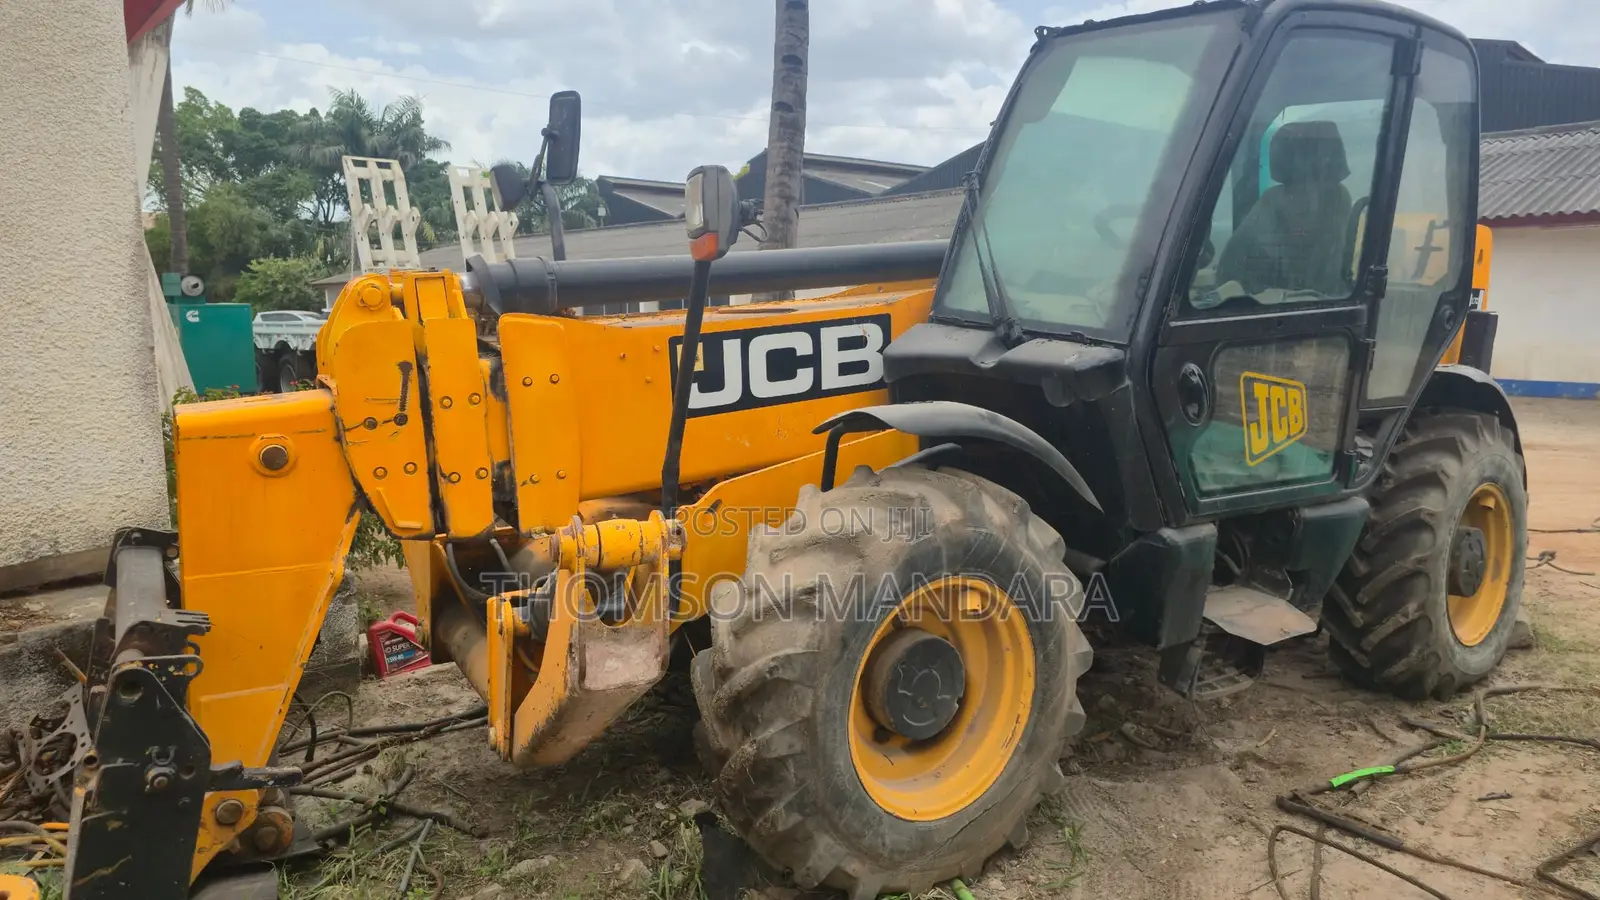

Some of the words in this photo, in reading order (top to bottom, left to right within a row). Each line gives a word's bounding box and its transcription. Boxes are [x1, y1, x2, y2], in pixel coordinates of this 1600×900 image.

[682, 323, 884, 409] JCB
[1250, 382, 1304, 455] JCB
[392, 642, 409, 651] SUPER
